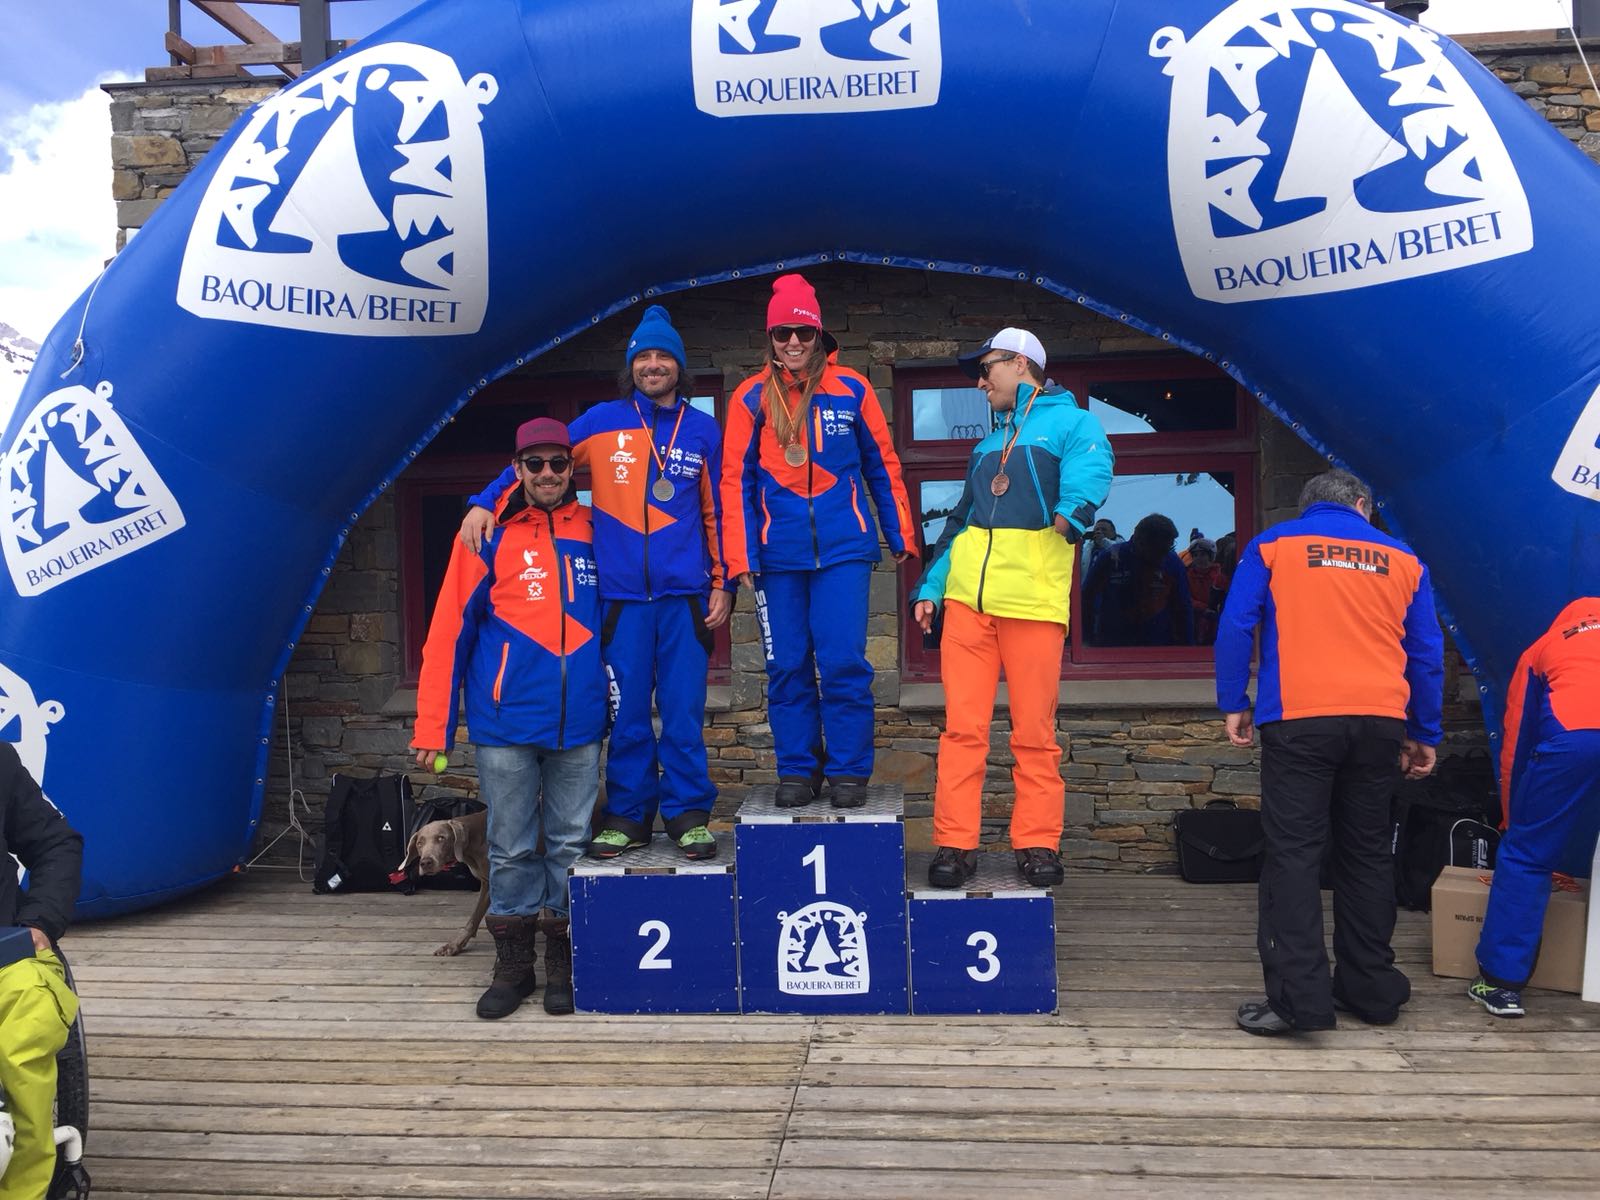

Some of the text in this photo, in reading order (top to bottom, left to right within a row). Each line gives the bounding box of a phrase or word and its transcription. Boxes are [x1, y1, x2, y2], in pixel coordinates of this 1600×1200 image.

[715, 70, 920, 104] BAQUEIRA/BERET
[1214, 211, 1502, 291] BAQUEIRA/BERET
[201, 275, 461, 324] BAQUEIRA/BERET
[26, 509, 168, 587] BAQUEIRA/BERET
[1307, 544, 1389, 567] SPAIN
[1321, 559, 1377, 573] NATIONAL TEAM
[755, 590, 775, 661] SPAIN
[802, 844, 827, 895] 1
[638, 919, 673, 970] 2
[966, 930, 1001, 982] 3
[786, 980, 862, 991] BAQUEIRA/BERET
